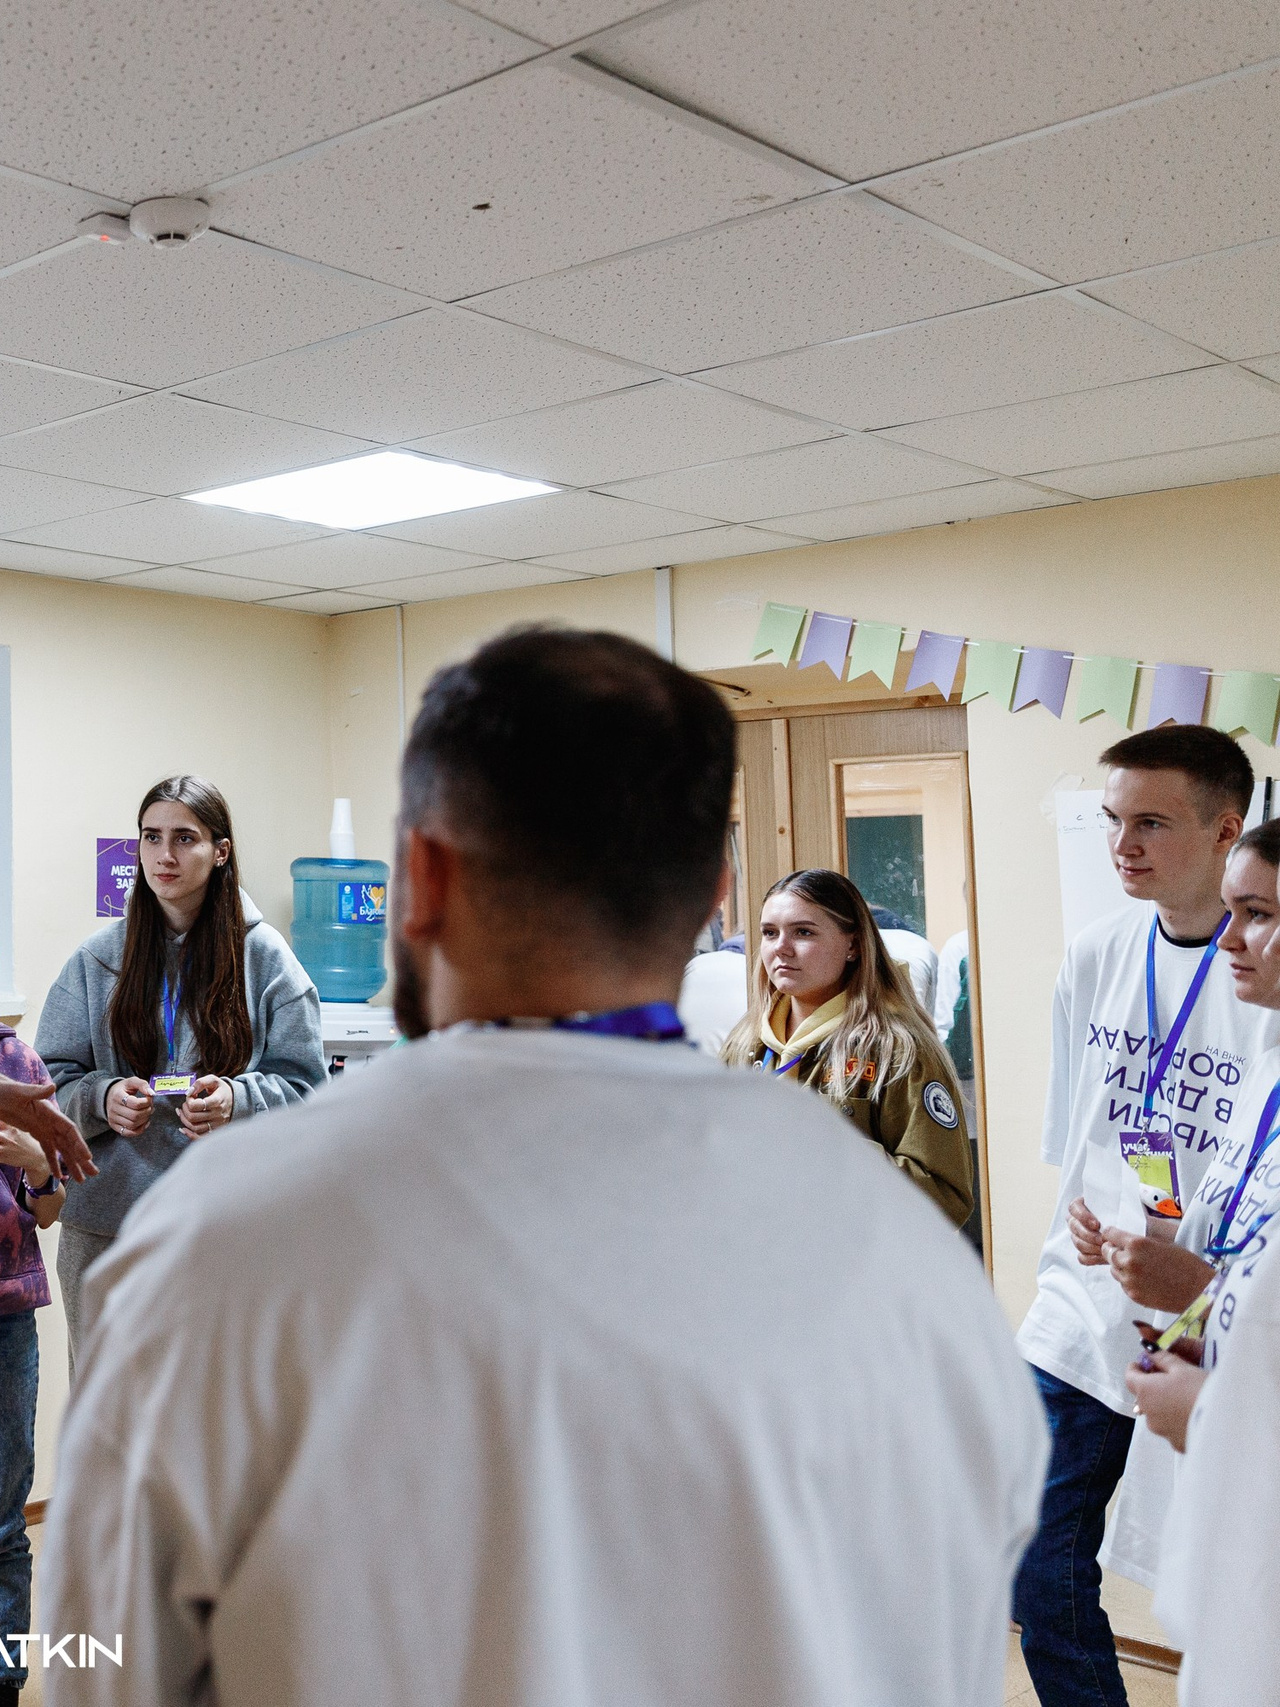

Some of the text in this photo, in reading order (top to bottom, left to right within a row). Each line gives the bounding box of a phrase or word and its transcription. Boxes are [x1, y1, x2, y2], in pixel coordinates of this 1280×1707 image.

[111, 865, 138, 877] МЕСТ
[115, 877, 135, 889] ЗАР
[1205, 1045, 1247, 1066] НА ВНЖ
[1214, 1097, 1234, 1124] В
